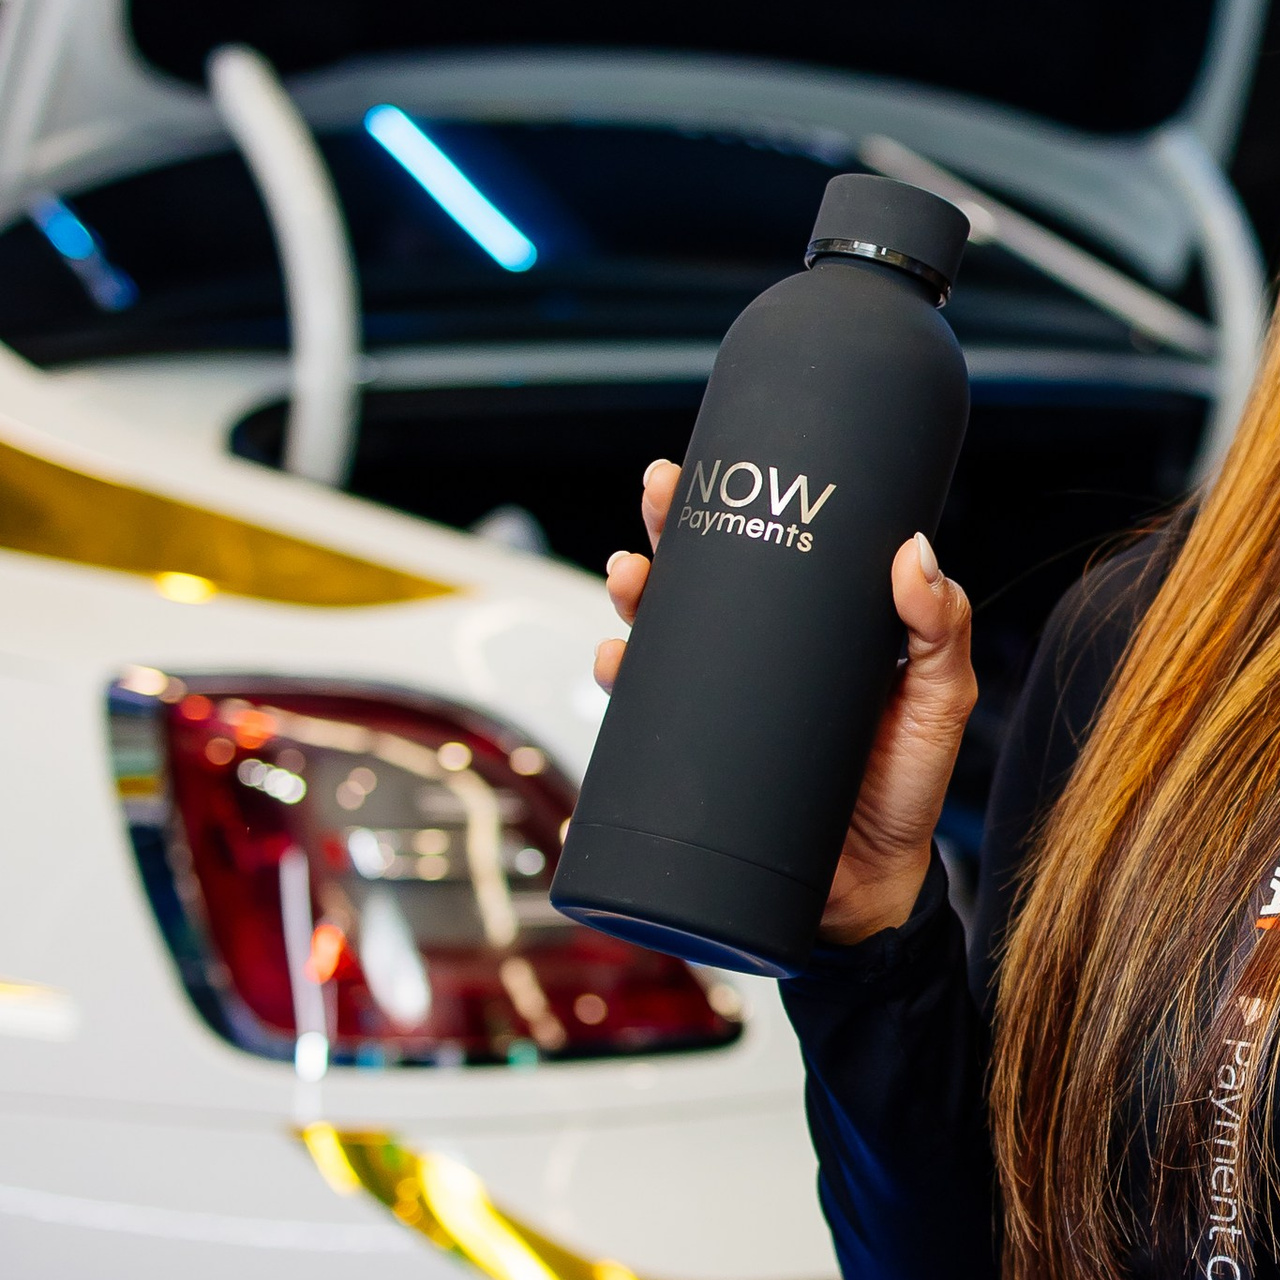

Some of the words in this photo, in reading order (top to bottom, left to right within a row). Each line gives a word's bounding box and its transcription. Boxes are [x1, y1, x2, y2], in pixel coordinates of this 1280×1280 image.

[685, 459, 837, 525] NOW
[677, 505, 814, 553] Payments
[1207, 1038, 1252, 1241] Payment
